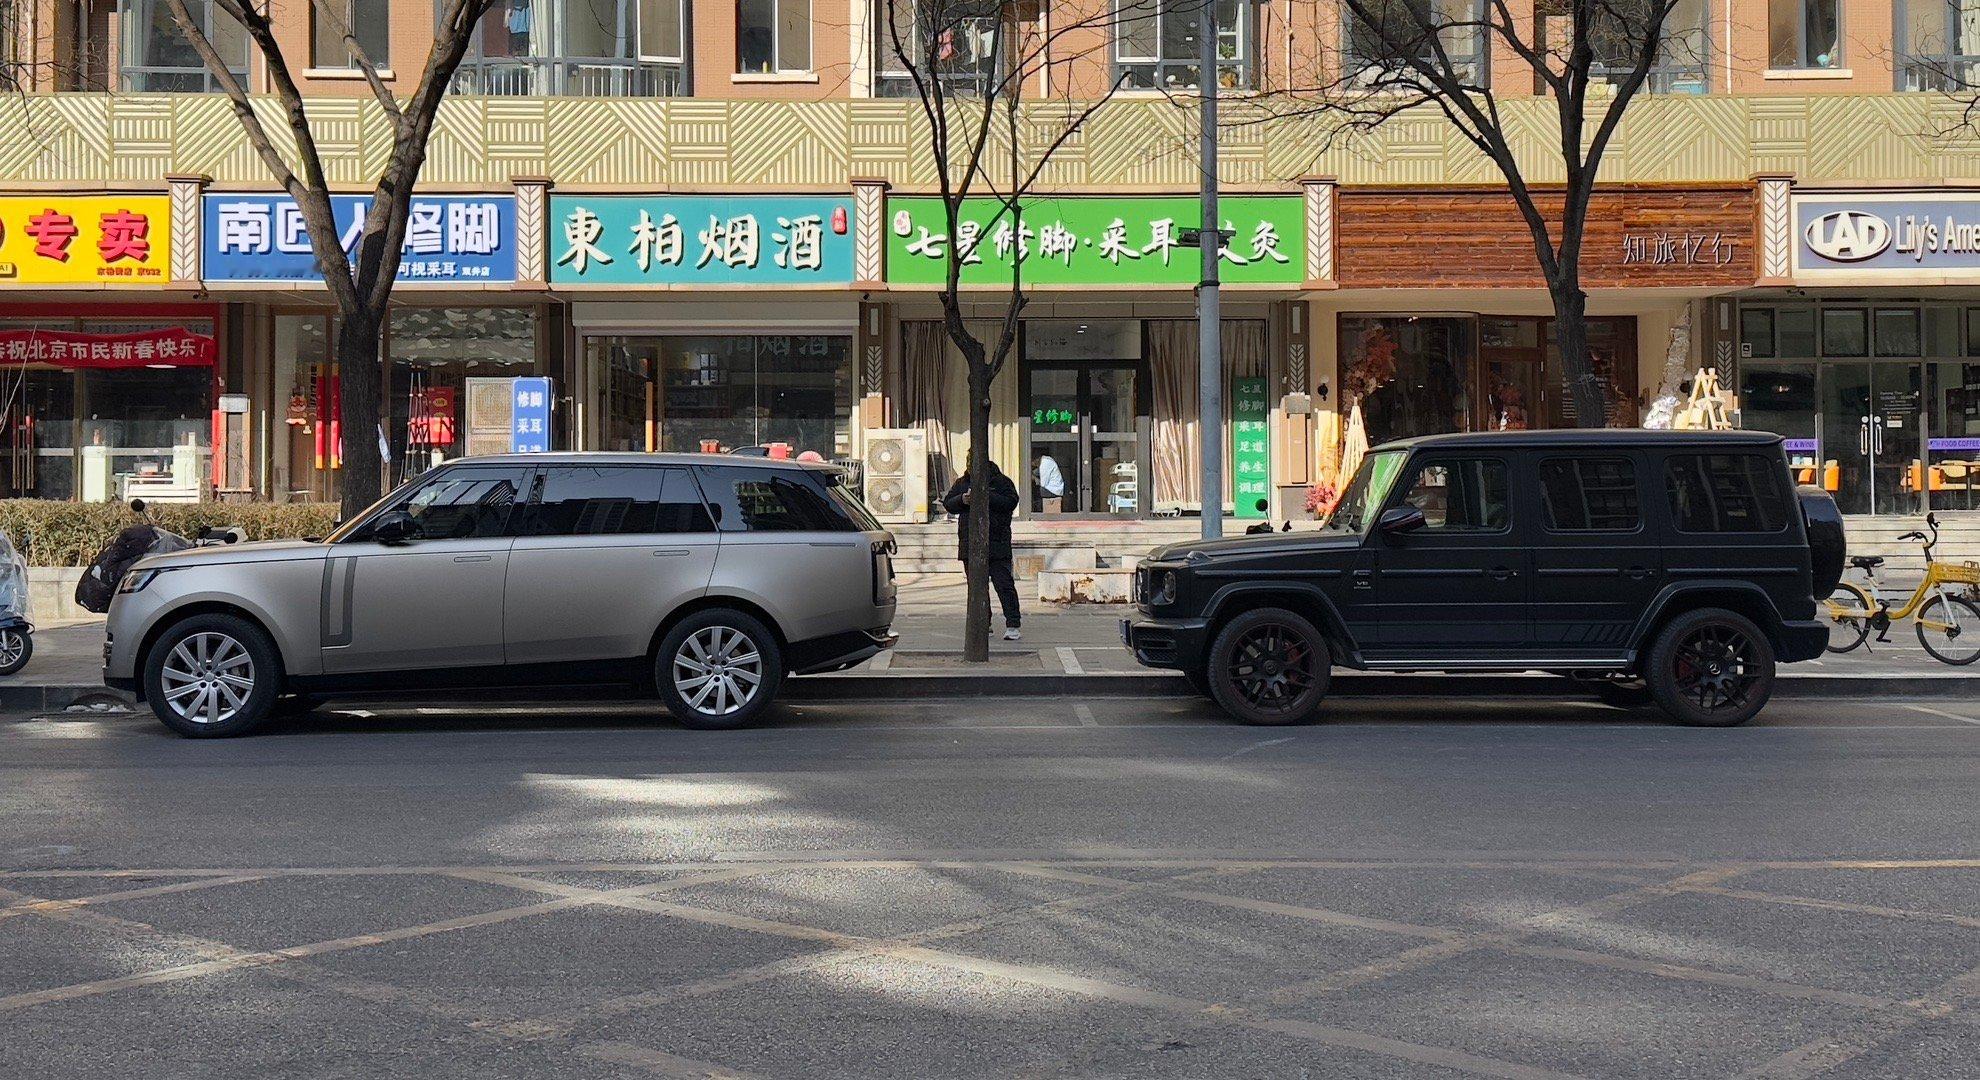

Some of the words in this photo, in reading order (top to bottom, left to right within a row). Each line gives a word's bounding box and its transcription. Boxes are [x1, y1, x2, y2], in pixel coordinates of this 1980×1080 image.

[24, 208, 151, 263] 专卖
[557, 206, 823, 274] 東柏烟酒
[1810, 211, 1888, 257] LAD
[1895, 215, 1938, 262] Lily's
[1624, 232, 1737, 264] 知旅忆行
[0, 338, 206, 361] 祝北京市民新春快乐！
[517, 391, 544, 408] 修脚
[1240, 384, 1262, 394] 七星
[1239, 400, 1265, 412] 修脚
[517, 418, 543, 435] 采耳
[1239, 461, 1266, 474] 养生
